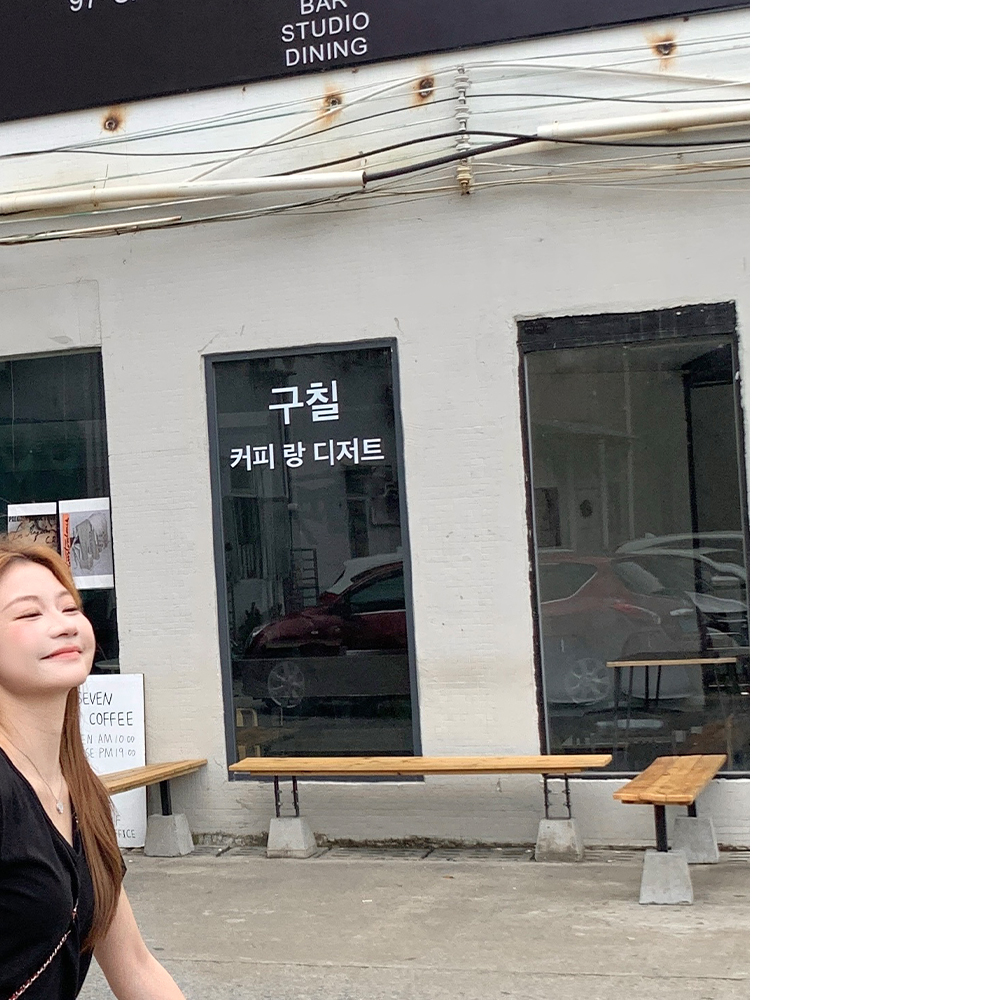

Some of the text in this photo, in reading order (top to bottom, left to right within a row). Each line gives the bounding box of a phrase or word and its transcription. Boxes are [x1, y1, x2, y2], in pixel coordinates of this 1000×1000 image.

[300, 0, 347, 15] BAR
[281, 12, 369, 42] STUDIO
[286, 37, 367, 67] DINING
[268, 380, 340, 425] 구칠
[230, 438, 385, 471] 커피 랑 디저트
[89, 711, 134, 727] COFFEE
